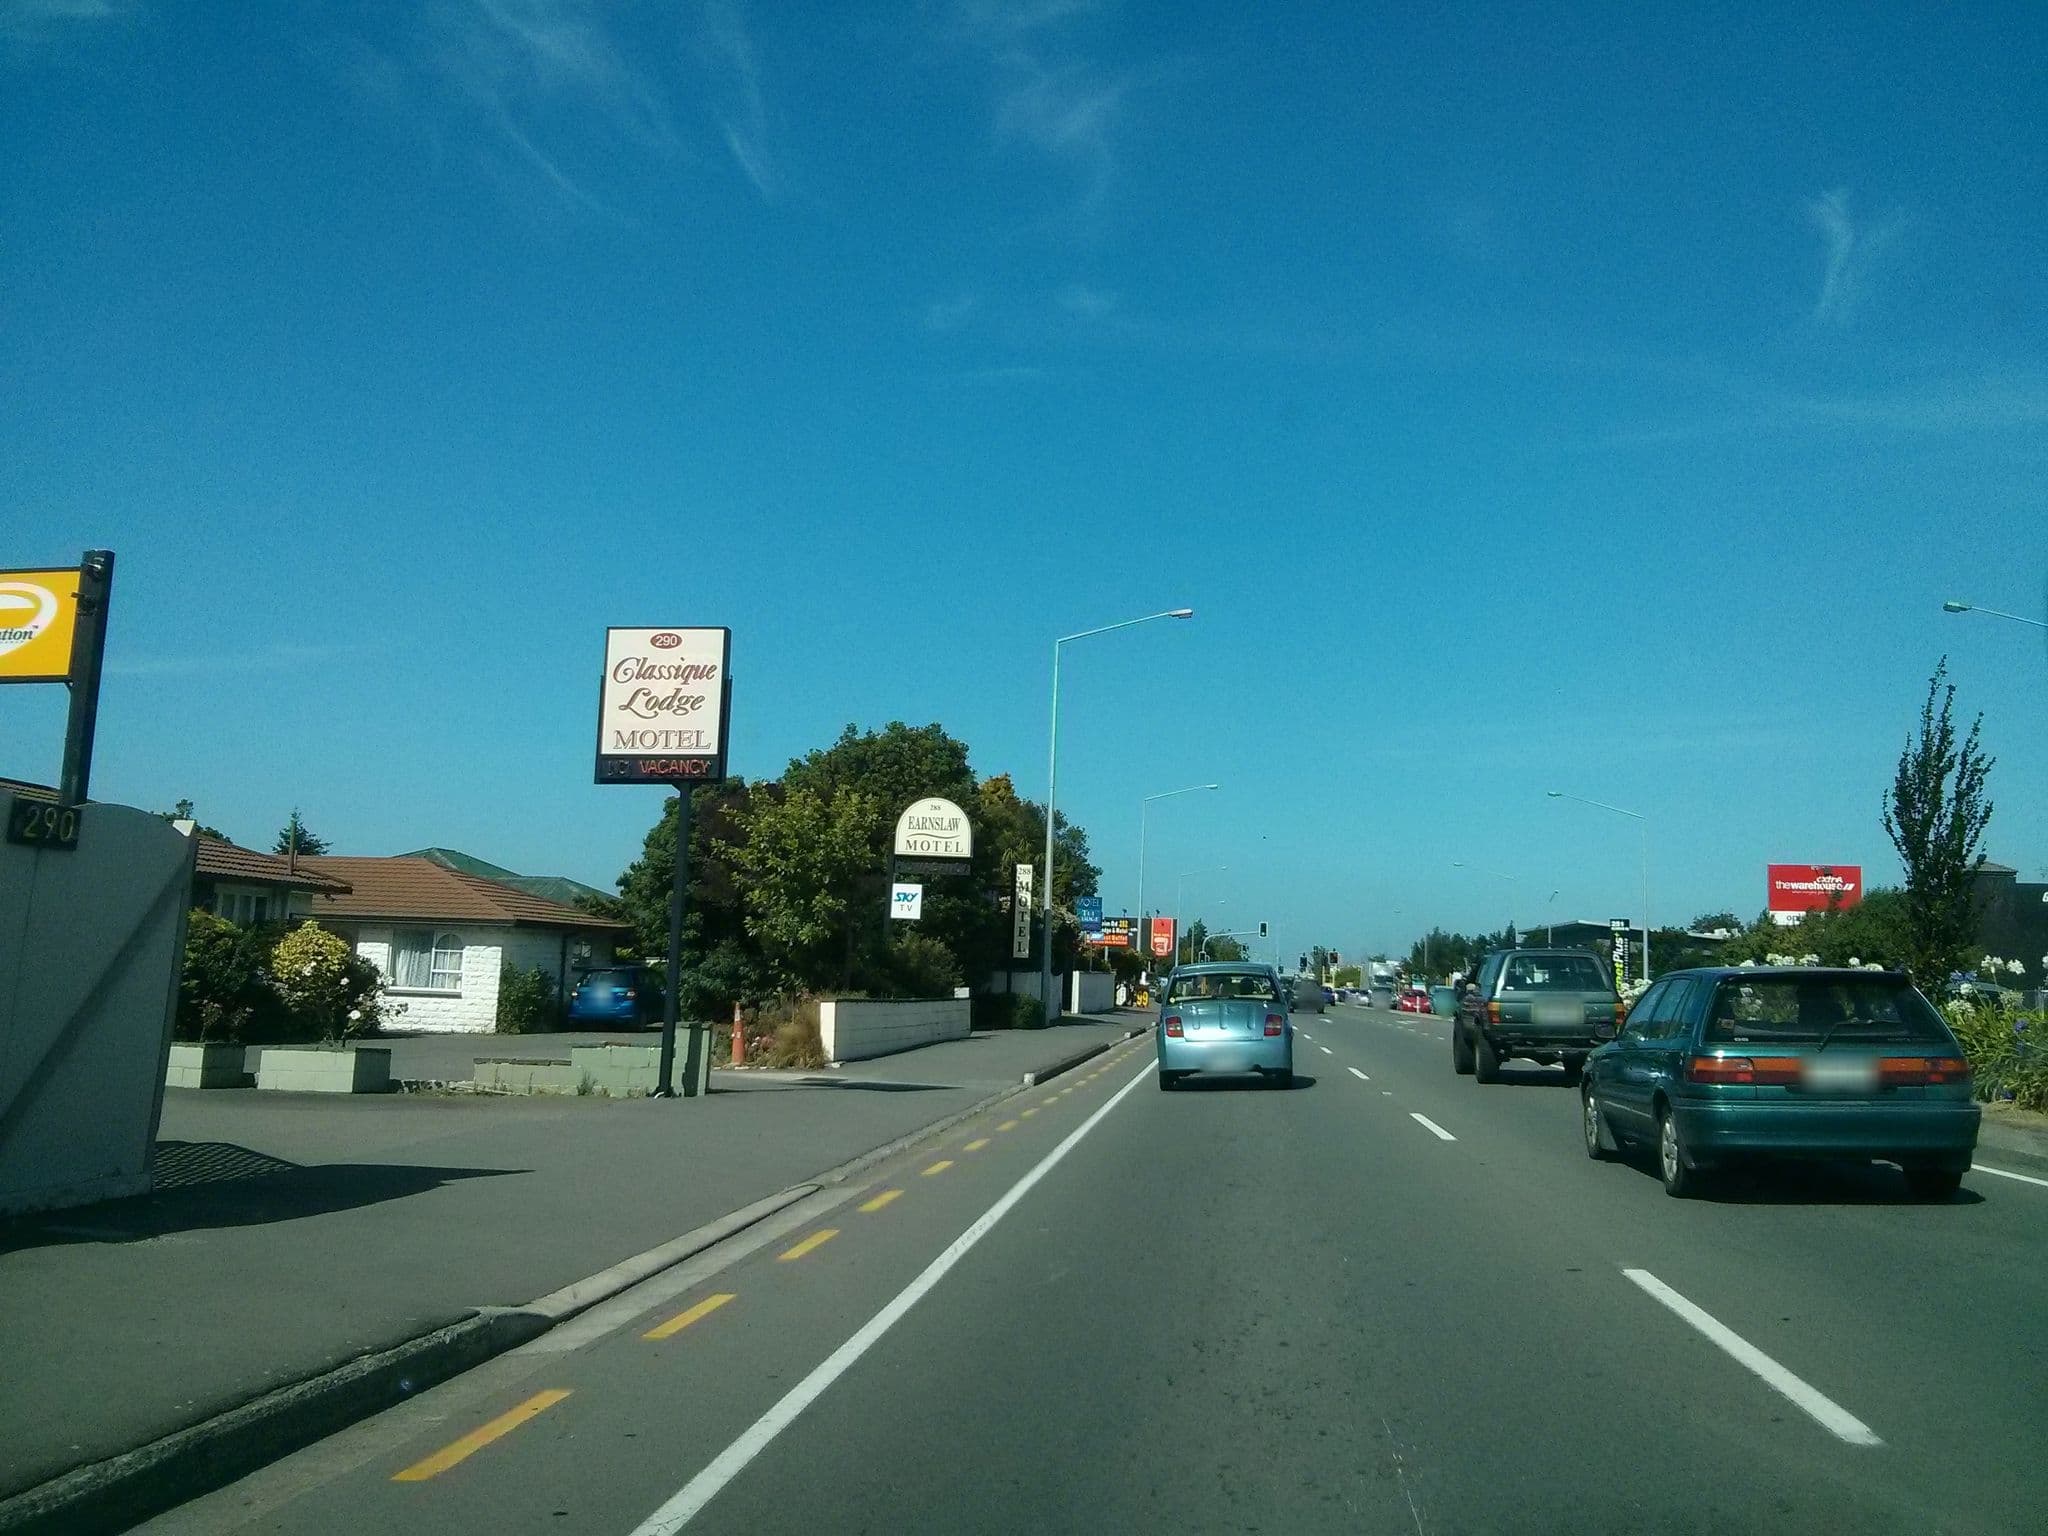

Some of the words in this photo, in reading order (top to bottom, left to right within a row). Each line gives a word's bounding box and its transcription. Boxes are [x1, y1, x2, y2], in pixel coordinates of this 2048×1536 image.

[0, 627, 33, 641] tion
[655, 635, 679, 647] 290
[613, 656, 717, 685] Classique
[618, 687, 706, 720] Lodge
[613, 730, 712, 750] MOTEL
[640, 759, 712, 774] VACANCY
[24, 806, 74, 842] 290
[907, 815, 961, 832] EARNSLAW
[905, 839, 964, 853] MOTEL
[894, 892, 918, 903] SKY
[1016, 881, 1031, 953] MOTEL
